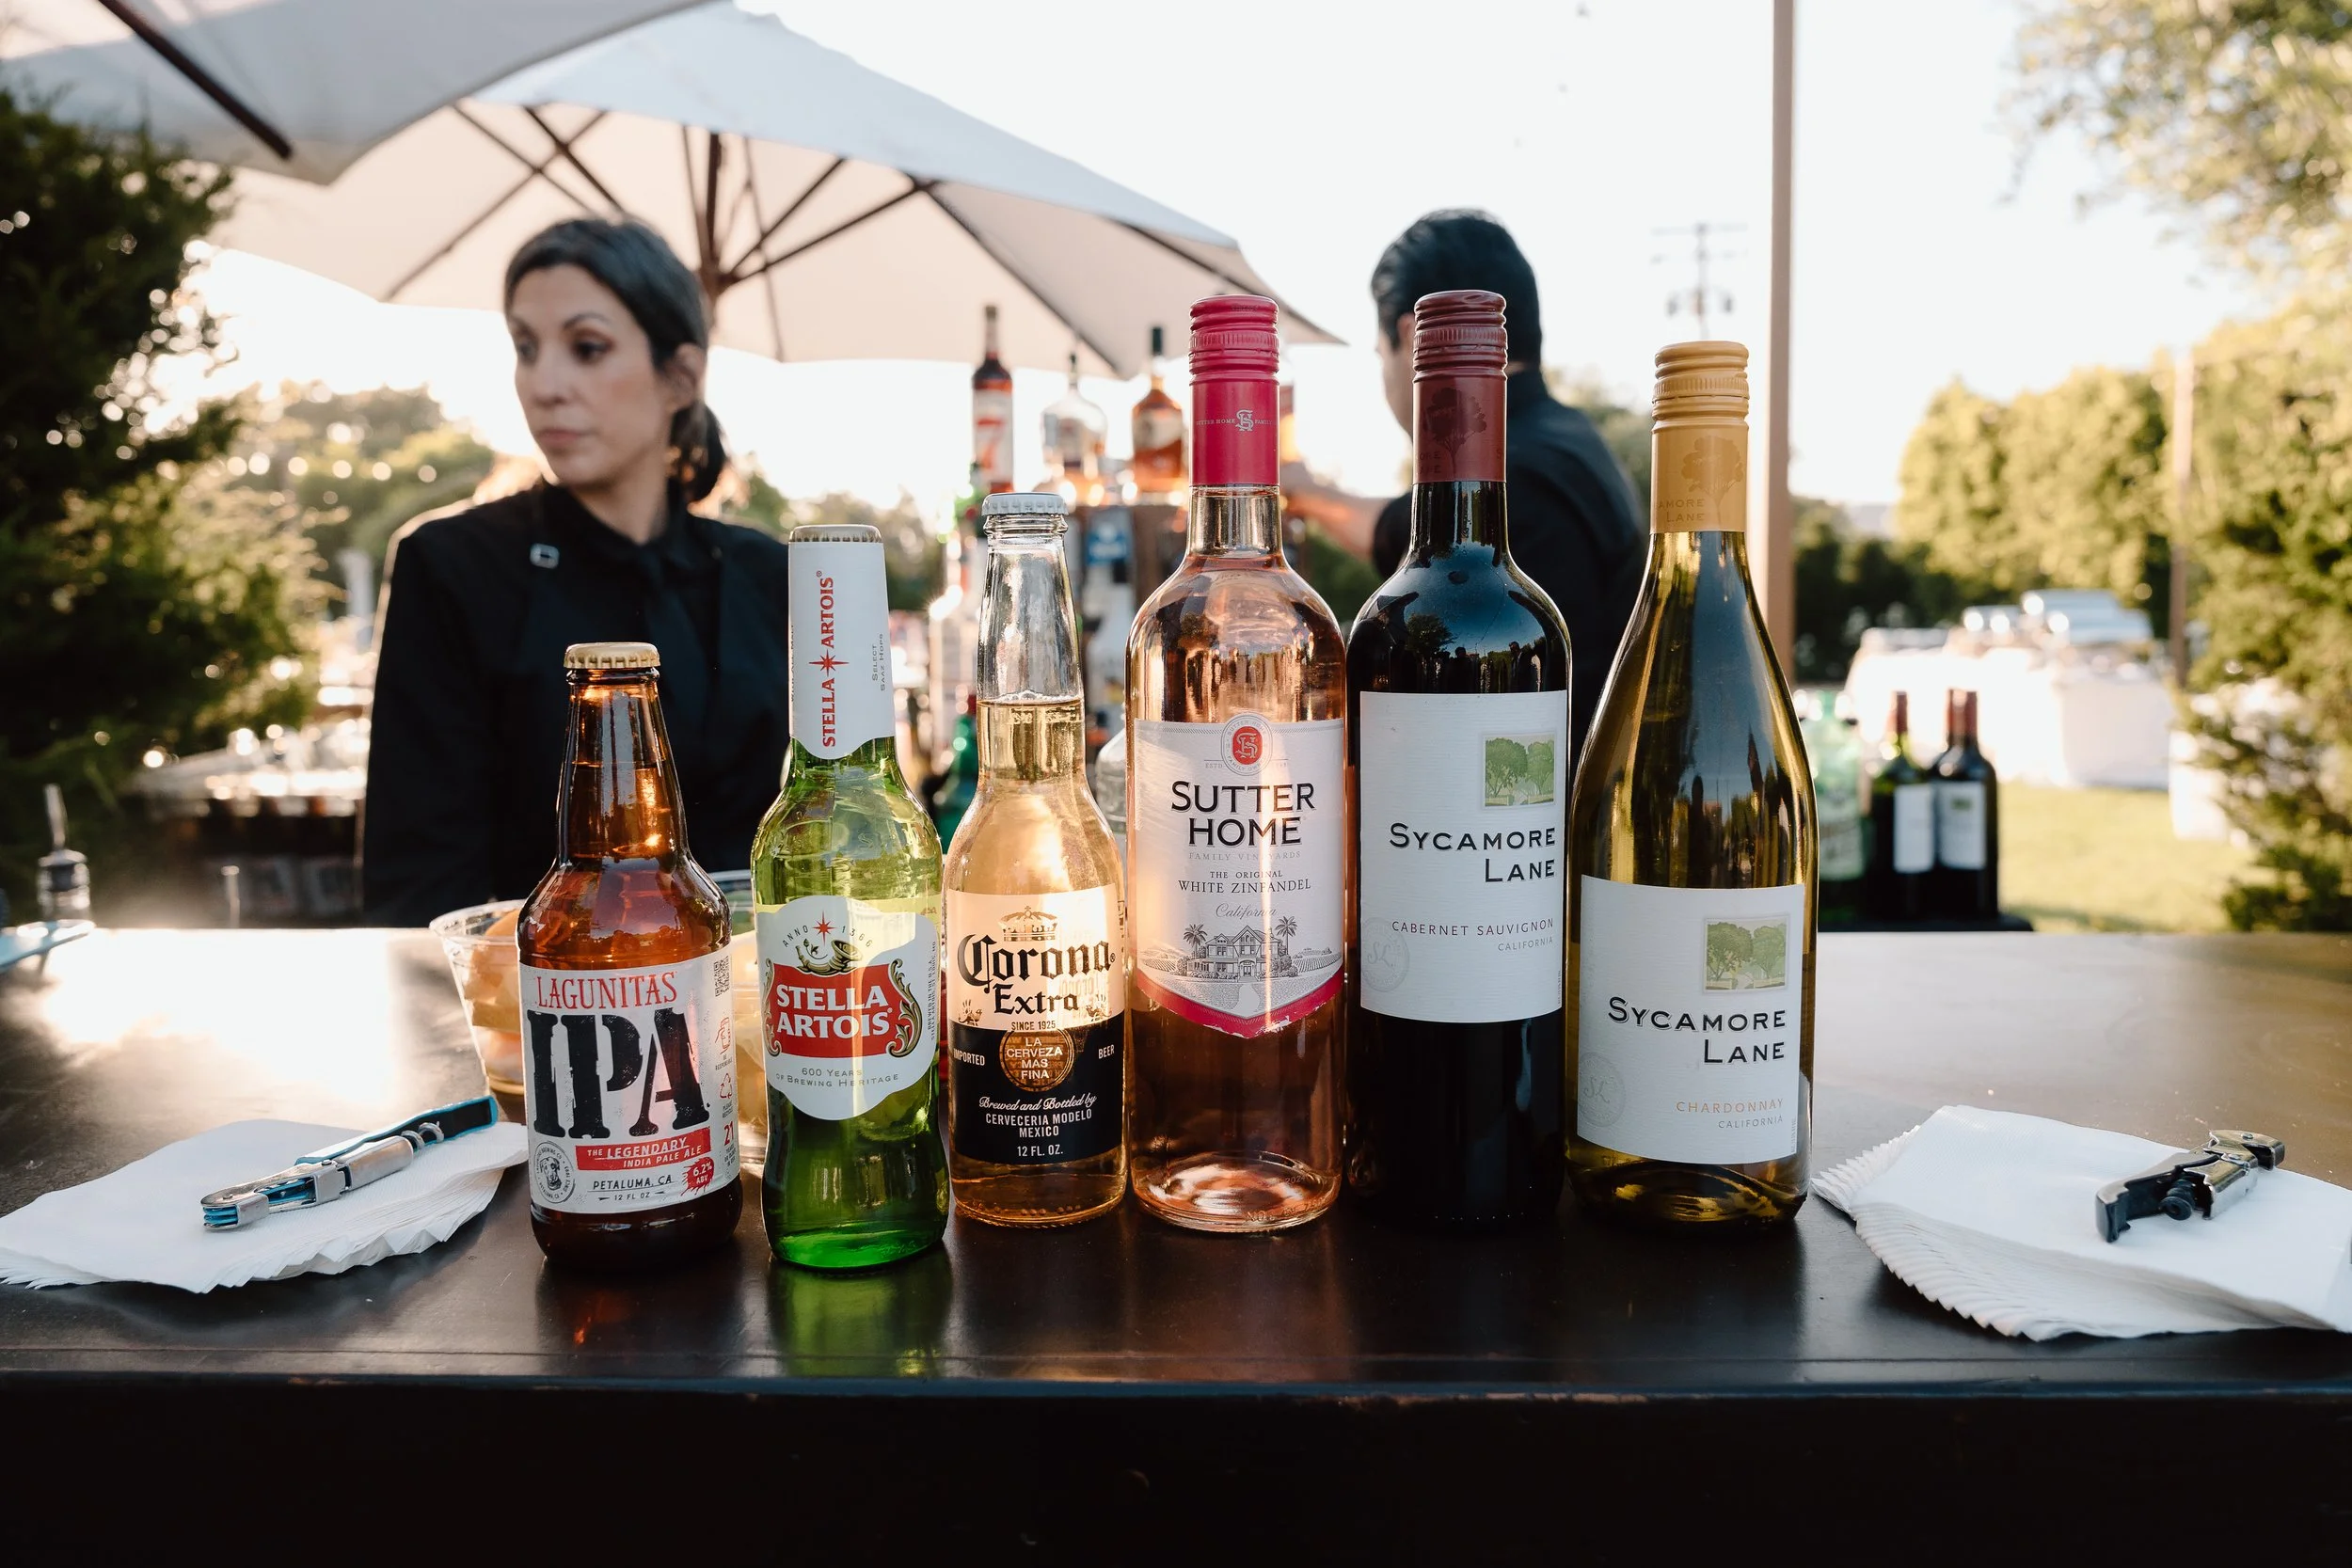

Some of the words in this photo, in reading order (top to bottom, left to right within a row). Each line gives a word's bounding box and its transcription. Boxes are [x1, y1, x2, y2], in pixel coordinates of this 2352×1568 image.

[819, 577, 834, 649] ARTOIS
[821, 677, 836, 748] STELLA
[1171, 780, 1316, 814] SUTTER
[1187, 816, 1303, 847] HOME
[1389, 822, 1556, 851] SYCAMORE
[1188, 851, 1232, 862] FAMILY
[1238, 850, 1302, 862] VINYARDS
[1235, 870, 1283, 879] ORIGINAL
[1485, 858, 1555, 883] LANE
[1178, 879, 1224, 895] WHITE
[1231, 879, 1311, 895] ZINFANDEL
[1215, 902, 1278, 920] Californa
[783, 925, 809, 947] ANNO
[841, 926, 873, 948] 1366
[1391, 921, 1470, 937] CABERNET
[1477, 918, 1554, 937] SAUVIGNON
[1497, 937, 1554, 952] CALIFORNIA
[957, 933, 1110, 994] Corona
[536, 972, 677, 1009] LAGUNITAS
[776, 984, 889, 1011] STELLA
[993, 983, 1079, 1015] Extra
[1608, 996, 1787, 1032] SYCAMORE
[776, 1011, 891, 1038] ARTOIS
[1010, 1021, 1035, 1031] SINCE
[1038, 1020, 1056, 1030] 1925
[1025, 1037, 1042, 1047] LA
[953, 1048, 986, 1066] IMPORTED
[1006, 1046, 1063, 1058] CERVEZA
[1098, 1044, 1115, 1060] BEER
[1703, 1039, 1785, 1065] LANE
[1021, 1058, 1048, 1069] MAS
[527, 1007, 710, 1139] IPA
[776, 1072, 786, 1081] OF
[787, 1074, 833, 1087] BREWING
[838, 1073, 899, 1087] HERITAGE
[802, 1068, 822, 1077] 600
[827, 1069, 863, 1078] YEARS
[1021, 1069, 1050, 1080] FINA
[978, 1096, 1019, 1112] Brewed
[1019, 1099, 1042, 1112] and
[1042, 1094, 1084, 1112] Bottled
[1084, 1093, 1098, 1108] by
[1676, 1098, 1784, 1114] CHARDONNAY
[985, 1112, 1049, 1127] CERVECERIA
[1052, 1108, 1092, 1125] MODELO
[1718, 1116, 1784, 1130] CALIFORNIA
[723, 1120, 734, 1147] 21
[1019, 1125, 1059, 1138] MEXICO
[587, 1148, 603, 1158] THE
[607, 1136, 688, 1160] LEGENDARY
[623, 1158, 651, 1168] INDIA
[656, 1151, 679, 1163] PALE
[684, 1145, 702, 1158] ALE
[1017, 1146, 1028, 1157] 12
[1030, 1145, 1046, 1157] FL.
[1048, 1144, 1063, 1156] OZ.
[692, 1162, 712, 1177] 6.2%
[593, 1178, 654, 1190] PETALUMA,
[658, 1174, 673, 1185] CA
[695, 1174, 708, 1185] ABV
[627, 1193, 636, 1201] FL
[640, 1191, 650, 1199] OZ
